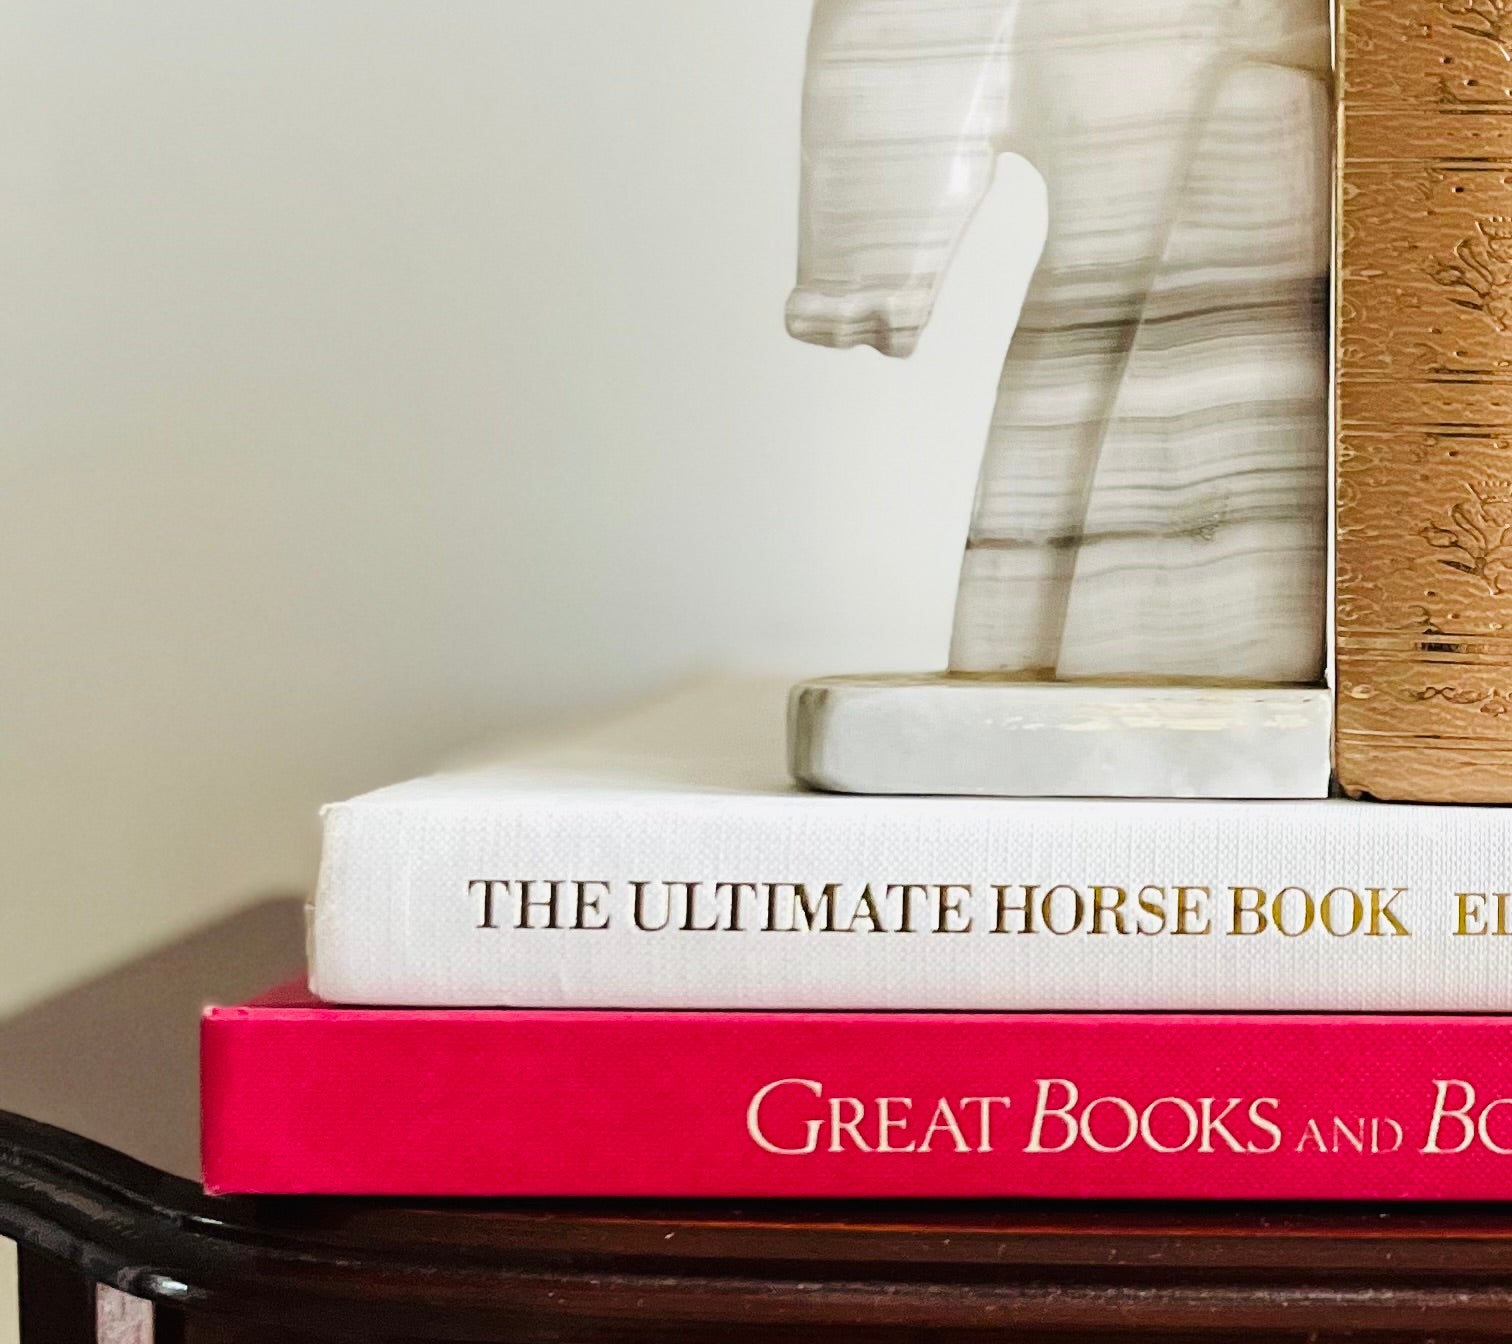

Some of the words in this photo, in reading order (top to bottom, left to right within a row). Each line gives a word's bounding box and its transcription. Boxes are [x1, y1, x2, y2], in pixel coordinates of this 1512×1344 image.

[468, 879, 611, 931] THE
[628, 880, 971, 934] ULTIMATE
[988, 884, 1210, 936] HORSE
[1226, 886, 1410, 937] BOOK
[746, 1078, 1010, 1156] GREAT
[1023, 1078, 1283, 1156] BOOKS
[1295, 1116, 1405, 1156] AND
